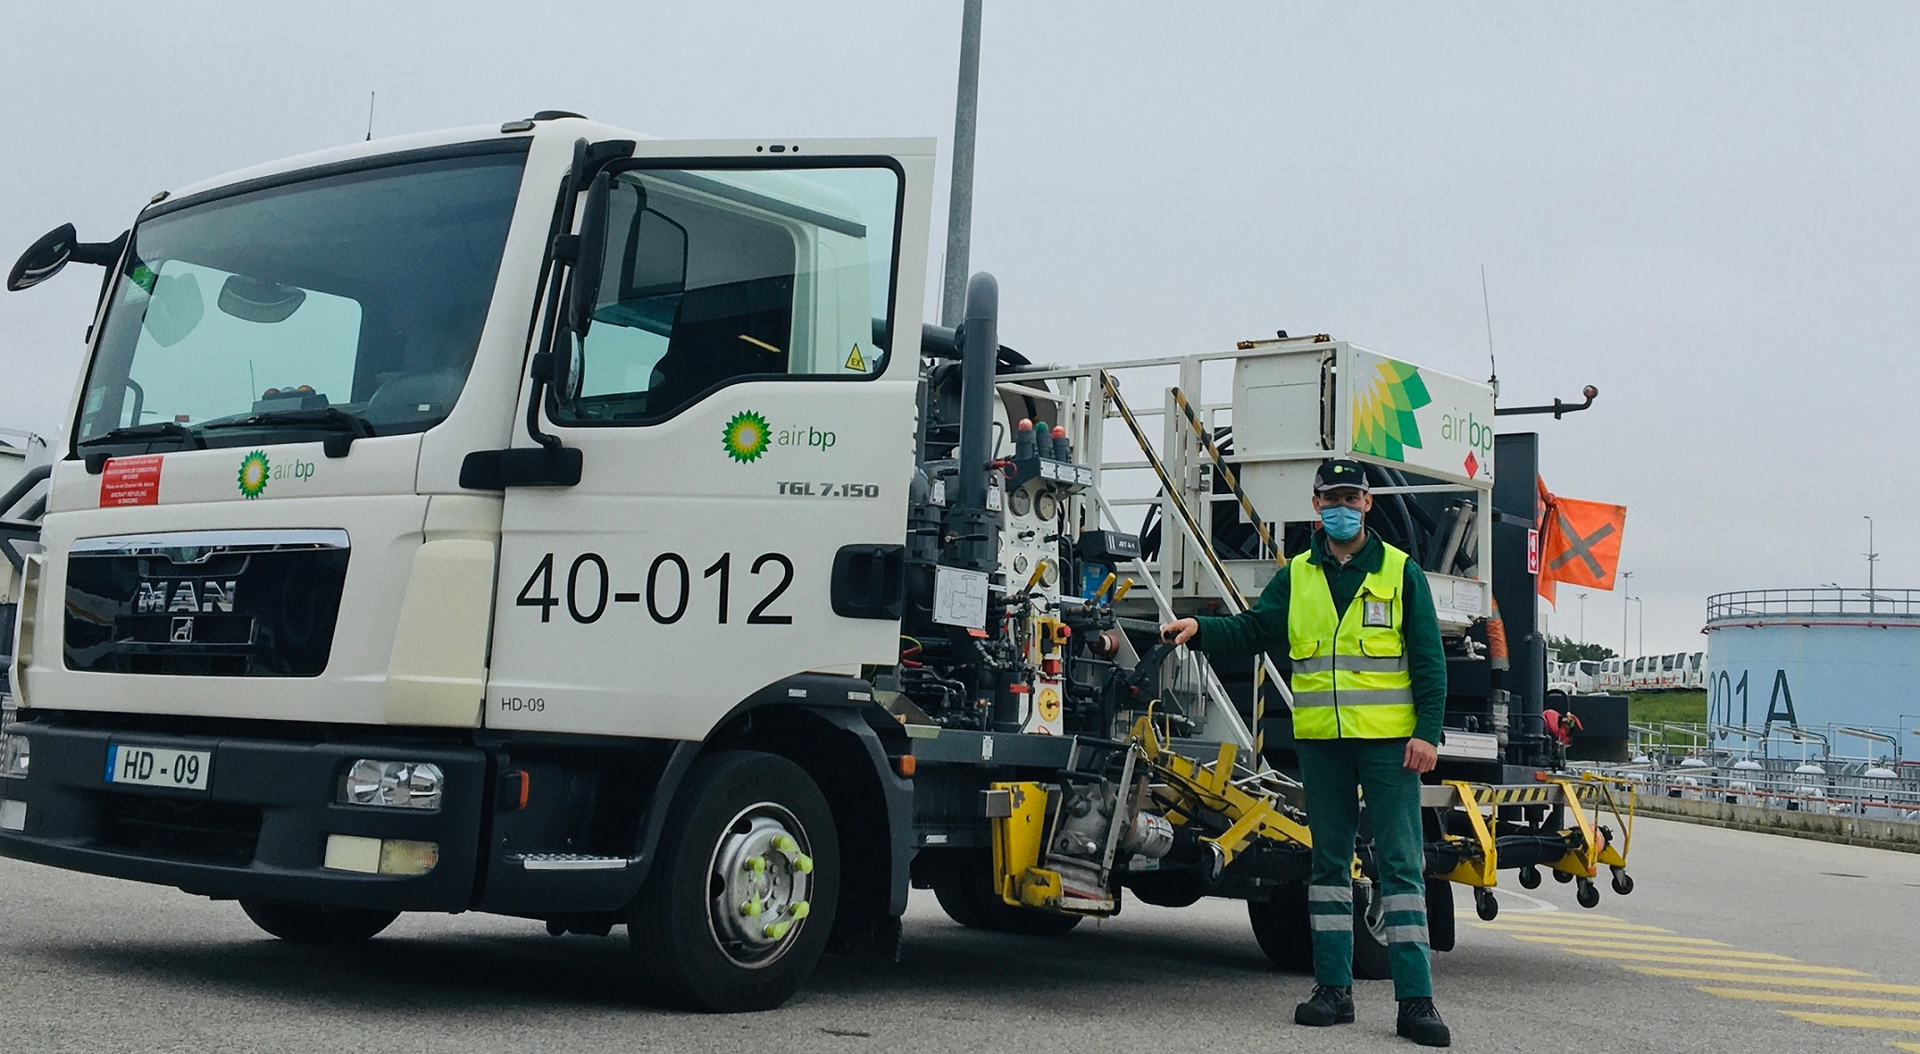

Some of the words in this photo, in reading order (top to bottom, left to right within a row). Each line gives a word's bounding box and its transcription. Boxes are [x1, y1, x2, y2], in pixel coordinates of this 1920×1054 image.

[851, 357, 862, 368] EX
[777, 481, 816, 496] TGL
[820, 482, 880, 499] 7.150
[138, 581, 237, 613] MAN
[515, 552, 795, 625] 40-012
[501, 697, 545, 712] HD-09
[1708, 669, 1748, 742] 201
[1763, 669, 1804, 744] A
